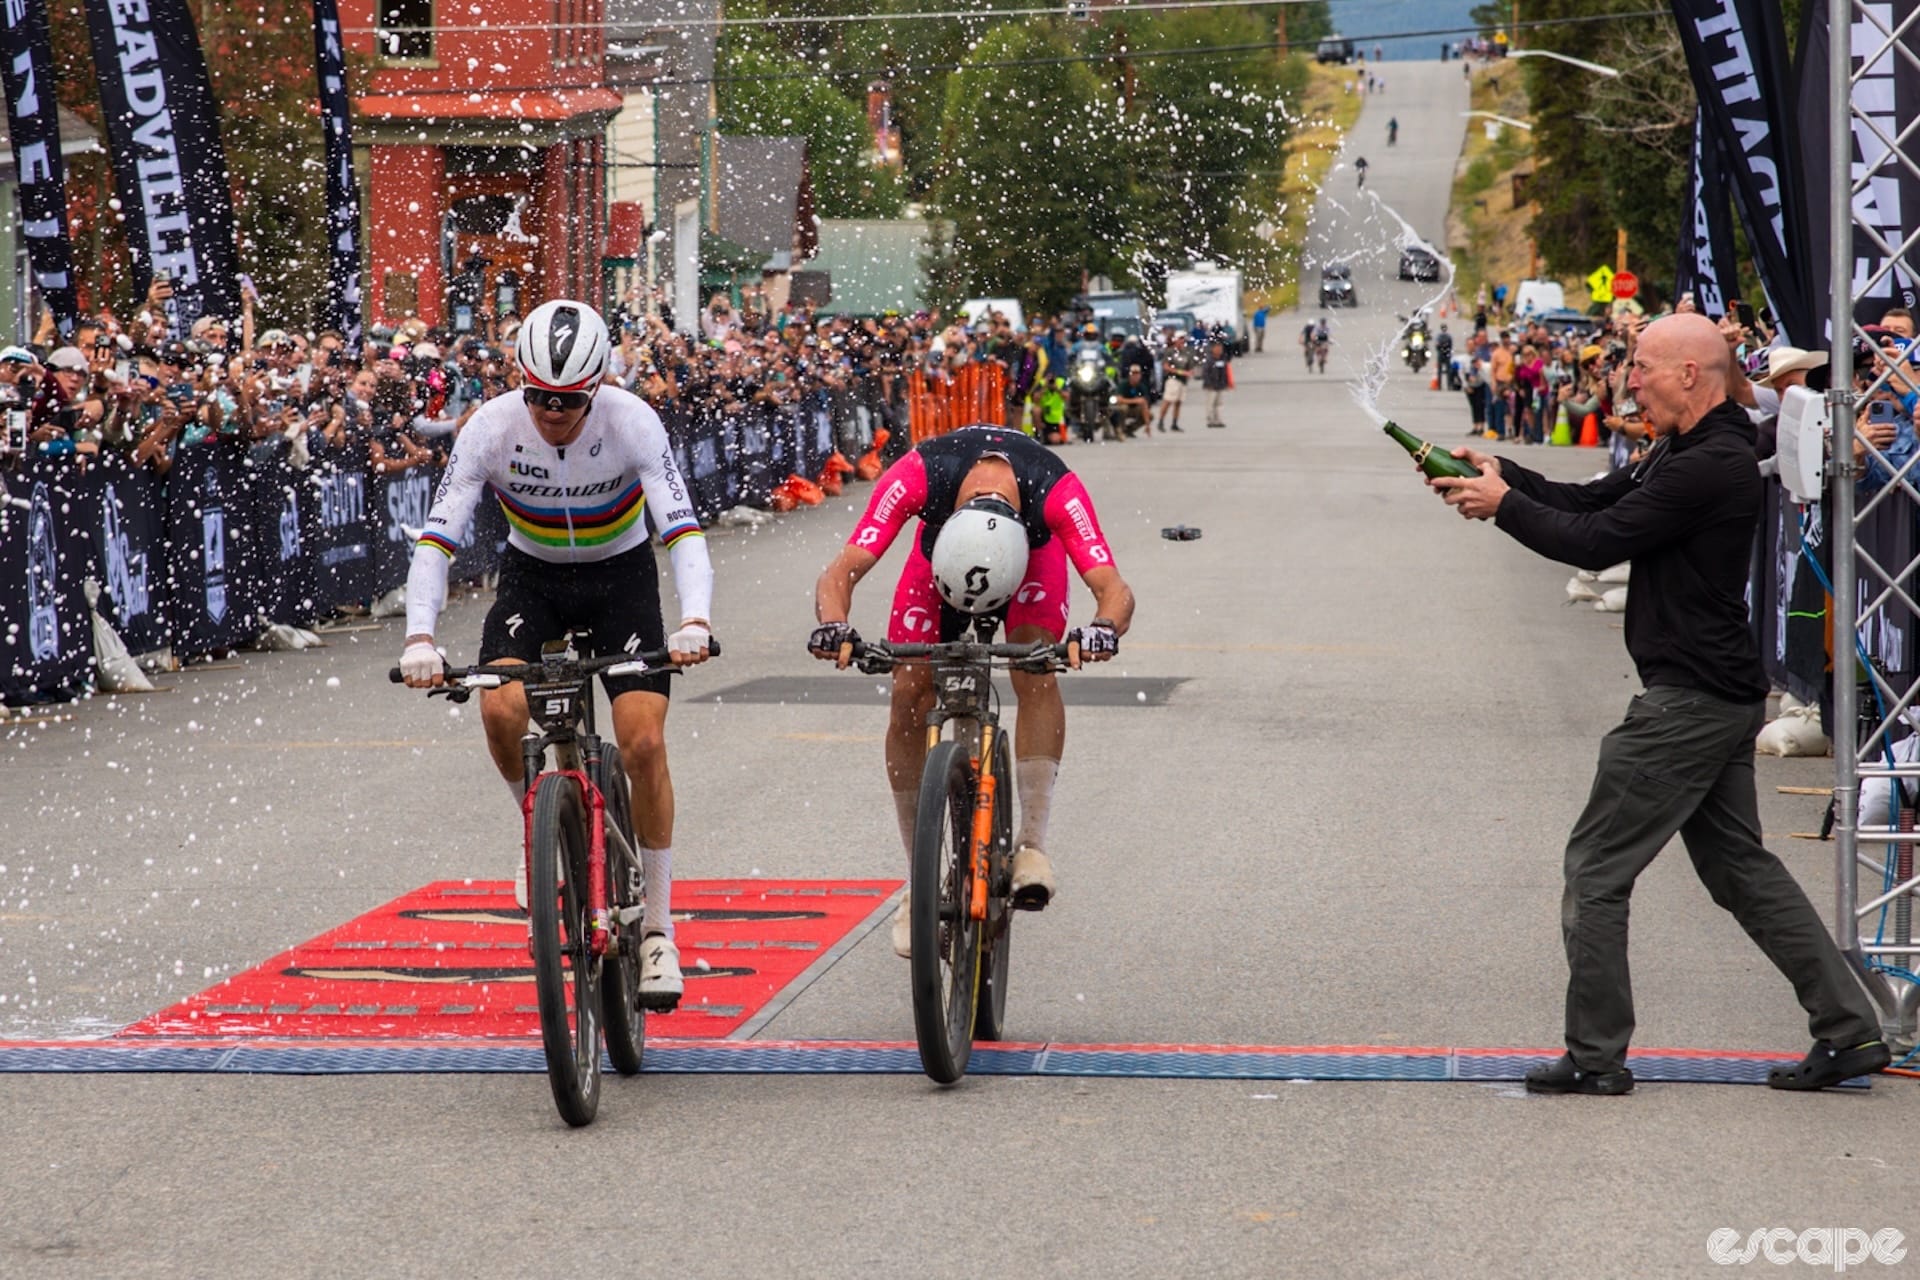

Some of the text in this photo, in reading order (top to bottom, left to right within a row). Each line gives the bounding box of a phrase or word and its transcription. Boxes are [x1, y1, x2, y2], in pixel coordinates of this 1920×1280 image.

[517, 461, 549, 480] UCI
[507, 474, 624, 498] SPECIALIZED
[1063, 496, 1098, 541] PIRELLI
[544, 697, 571, 716] 51
